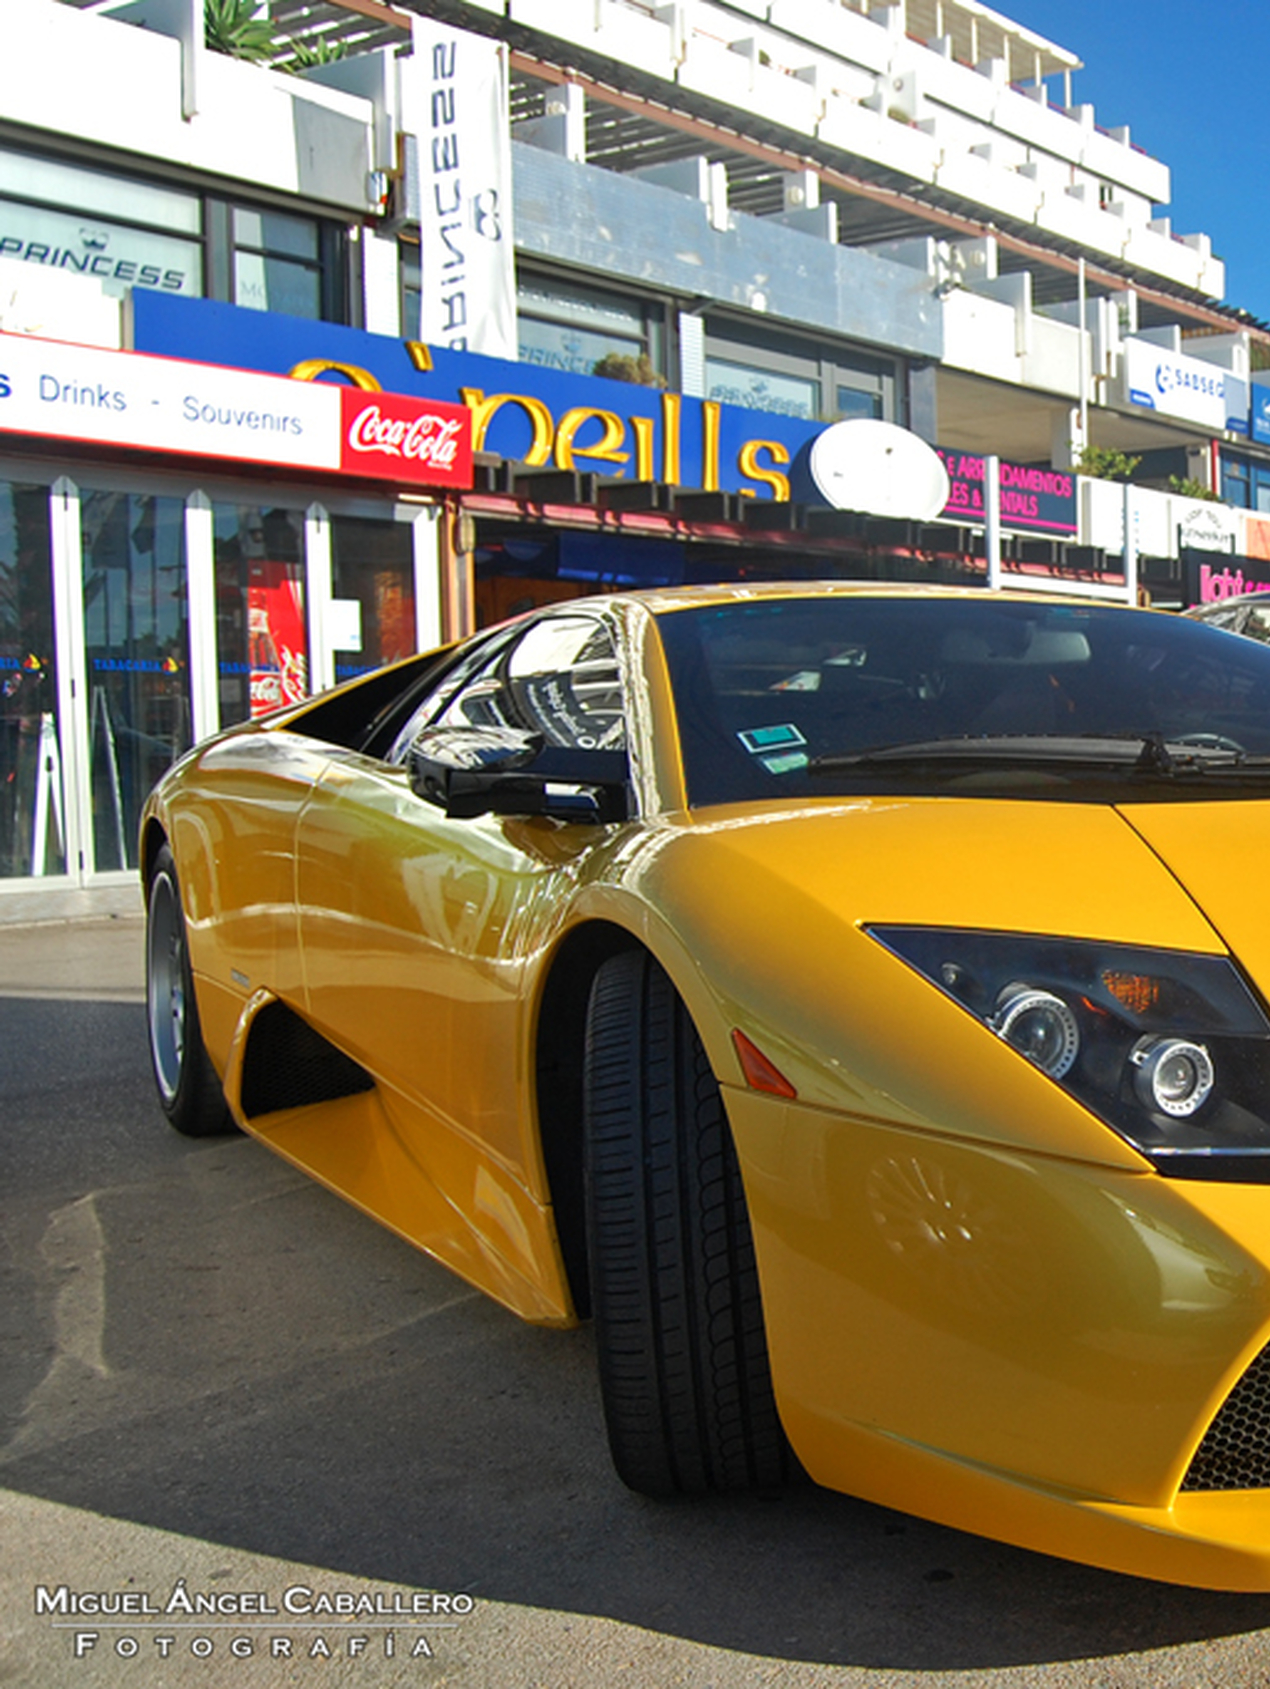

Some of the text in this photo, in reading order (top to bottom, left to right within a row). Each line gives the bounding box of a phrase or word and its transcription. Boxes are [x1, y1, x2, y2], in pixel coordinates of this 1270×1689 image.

[0, 237, 186, 291] PRINCESS
[39, 373, 128, 412] Drinks
[183, 395, 304, 436] Souvenirs
[348, 404, 463, 464] Coca-Cola
